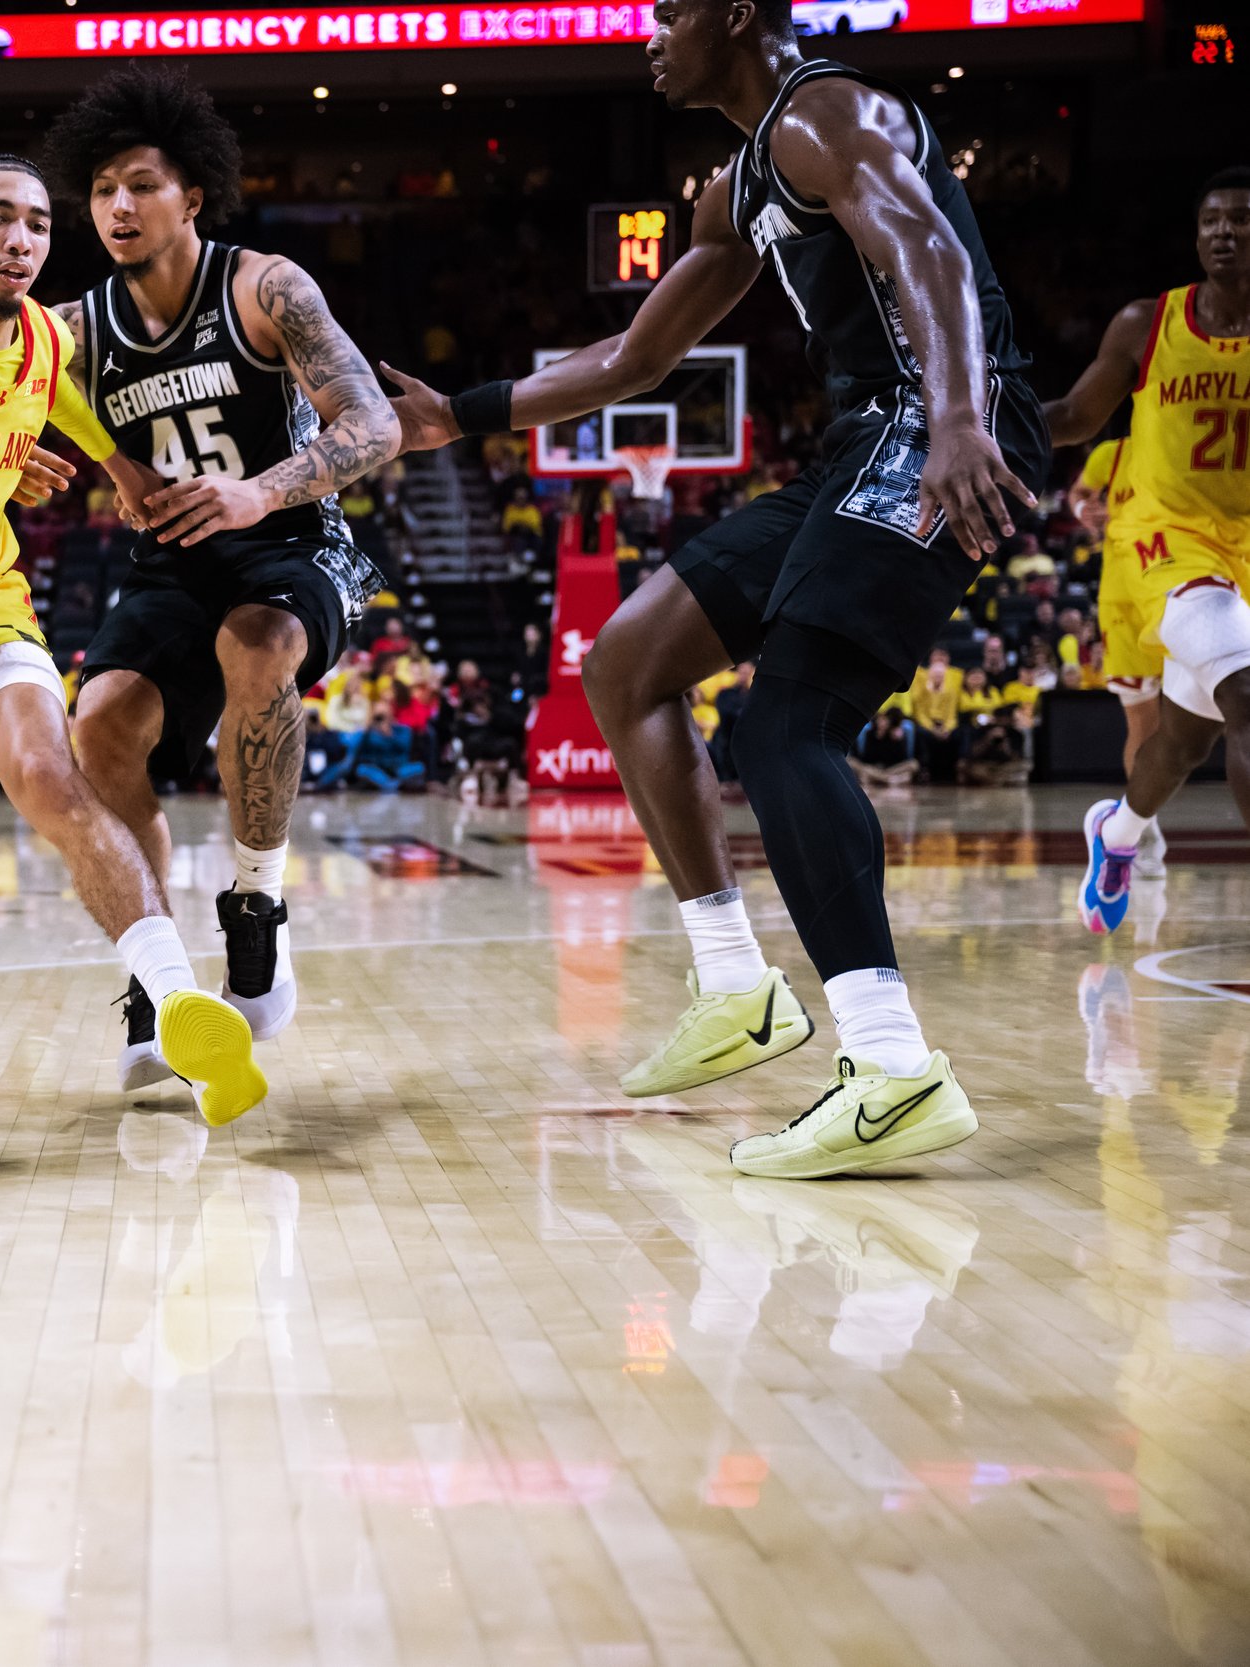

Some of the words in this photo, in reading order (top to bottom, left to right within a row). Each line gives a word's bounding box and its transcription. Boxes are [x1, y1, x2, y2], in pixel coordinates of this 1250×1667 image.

[76, 15, 307, 50] EFFICIENCY
[318, 12, 447, 45] MEETS
[619, 238, 659, 281] 14
[104, 361, 241, 428] GEORGETOWN
[151, 405, 246, 483] 45
[1190, 407, 1250, 472] 21
[536, 740, 618, 782] xfini
